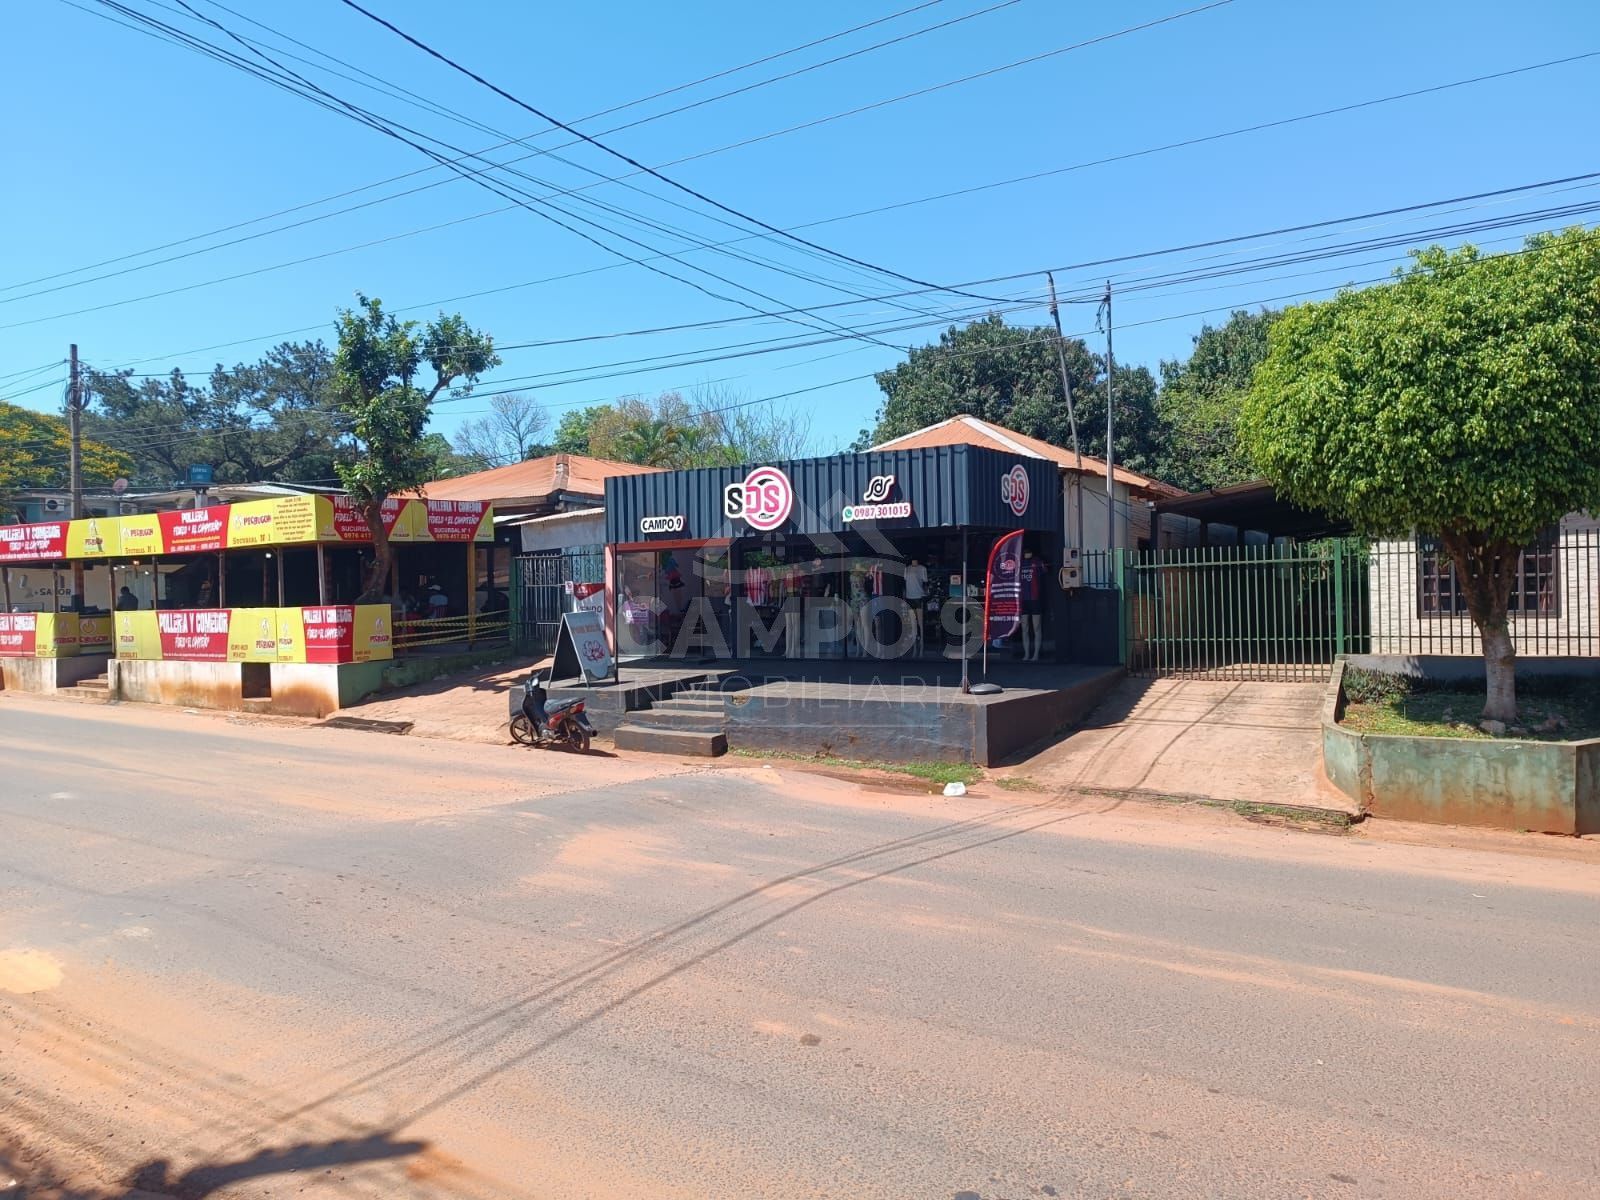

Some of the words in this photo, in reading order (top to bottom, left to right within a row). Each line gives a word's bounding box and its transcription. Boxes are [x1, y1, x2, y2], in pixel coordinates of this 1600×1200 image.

[1003, 477, 1025, 502] SDS
[727, 485, 780, 514] SDS
[458, 502, 482, 513] COMEDOR
[854, 508, 875, 518] 0987
[877, 505, 909, 517] 301015
[642, 519, 674, 531] CAMPO
[677, 518, 682, 530] 9
[26, 527, 31, 539] Y
[31, 525, 61, 539] COMEDOR
[189, 612, 195, 633] Y
[195, 612, 229, 633] COMEDOR
